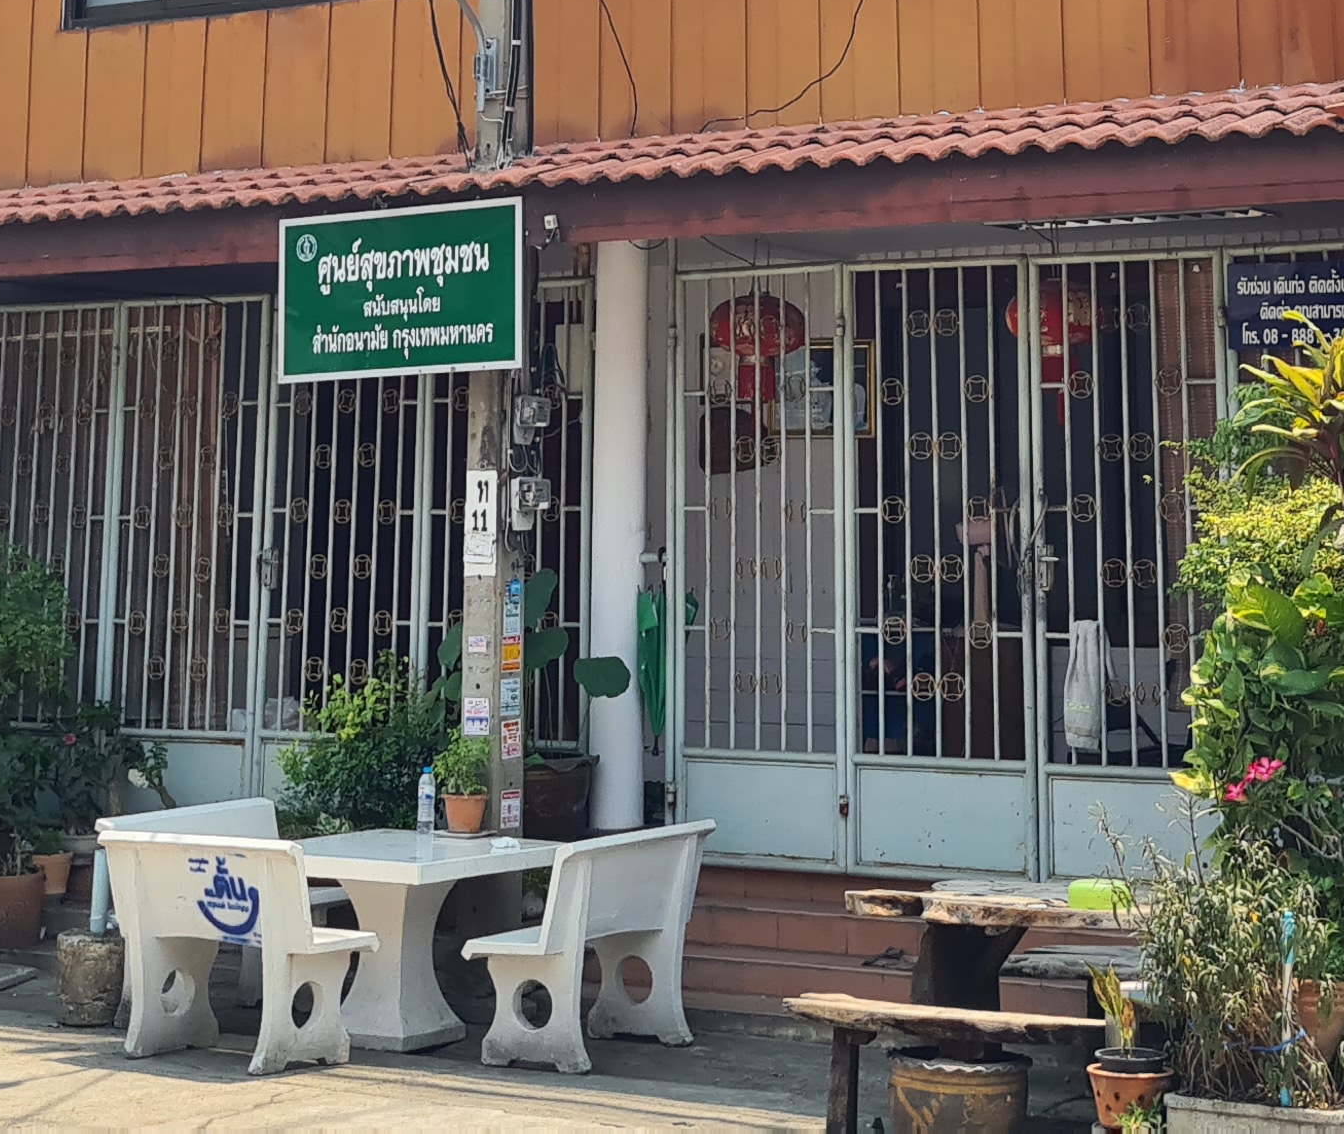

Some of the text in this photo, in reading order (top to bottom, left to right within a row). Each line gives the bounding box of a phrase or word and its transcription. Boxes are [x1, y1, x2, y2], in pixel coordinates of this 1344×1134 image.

[317, 238, 490, 296] ศูนย์สุขภาพชุมชน
[1236, 275, 1270, 295] รับซ่อม
[1273, 273, 1305, 294] เดินท่อ
[363, 287, 441, 321] สนับสนุนโดย
[312, 322, 494, 359] สำนักอนามัย กรุงเทพมหานคร
[472, 508, 488, 532] 11
